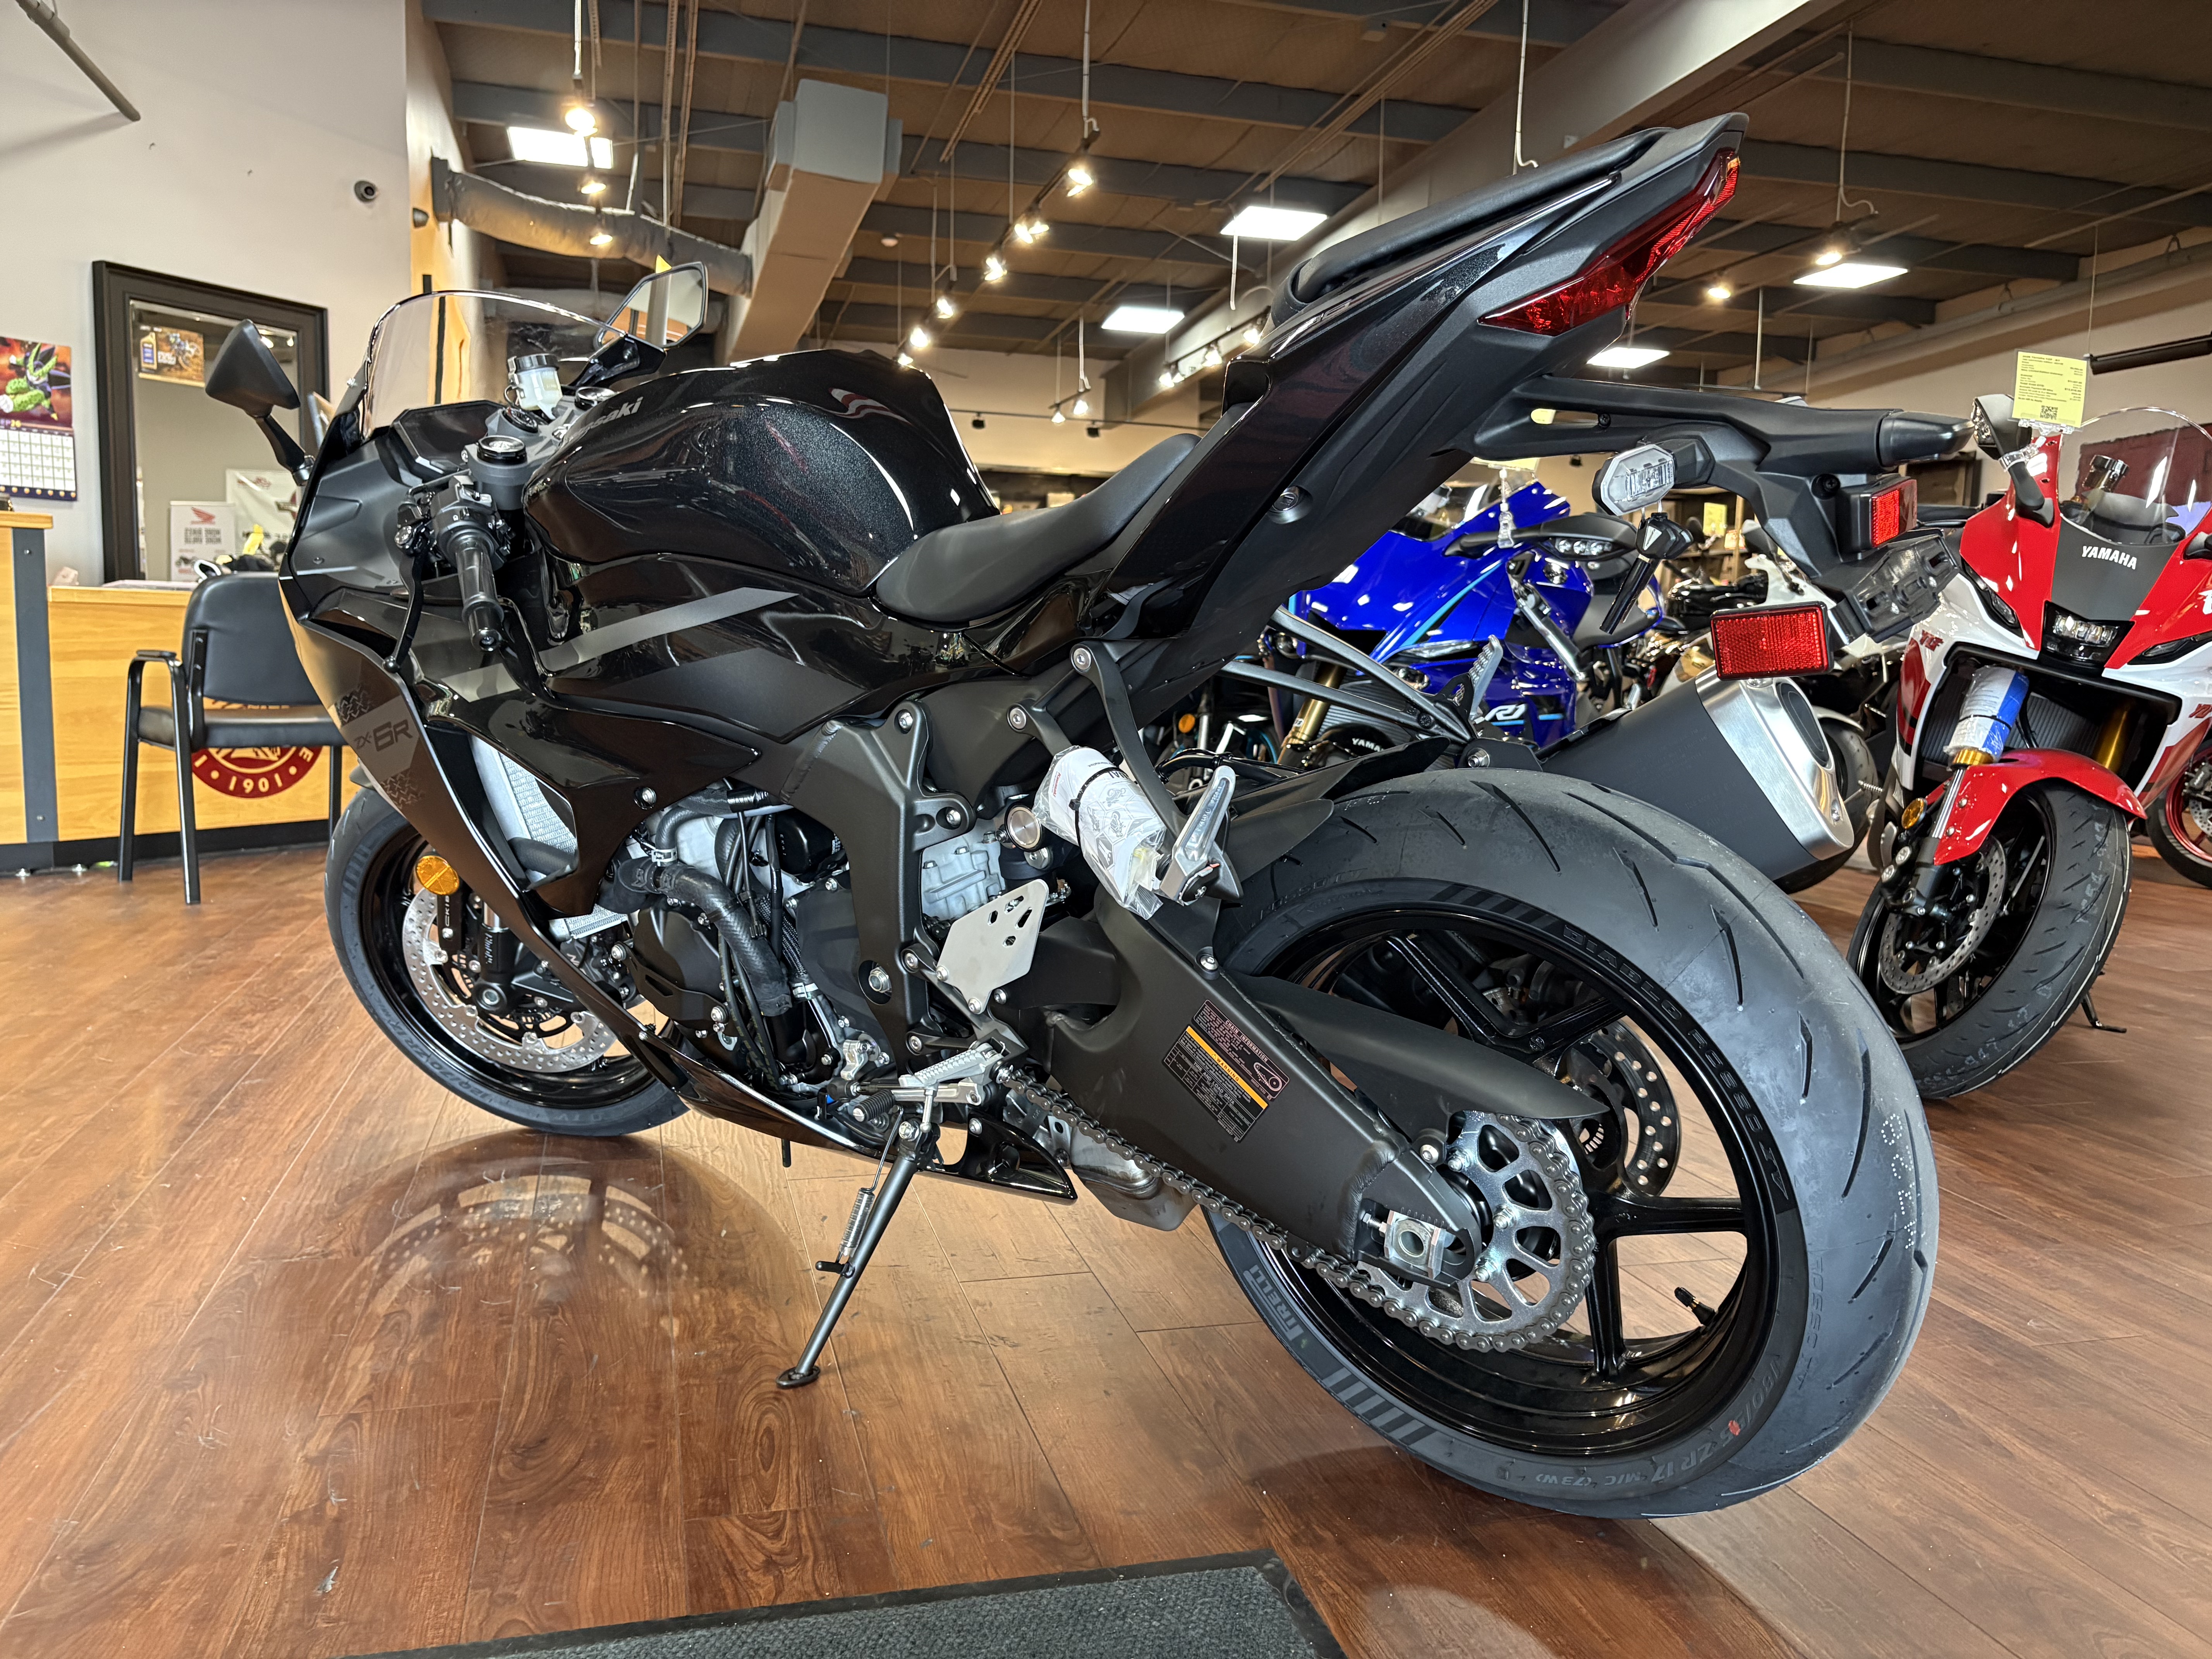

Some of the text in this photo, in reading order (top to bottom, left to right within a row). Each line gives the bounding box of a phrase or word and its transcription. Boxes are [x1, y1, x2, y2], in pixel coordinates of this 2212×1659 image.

[2082, 546, 2138, 569] YAMAHA
[354, 719, 413, 751] ZX-6R
[229, 773, 282, 793] 1901
[1224, 1020, 1268, 1062] CHAIN INFORMATION
[1563, 924, 1683, 1020] DIABLO
[1687, 1028, 1765, 1132] ROSSO
[1193, 1061, 1235, 1105] TIRE AND LOAD DATA
[1216, 1058, 1240, 1081] WARNING
[1243, 1264, 1304, 1341] PIRELLI
[1680, 1444, 1714, 1471] ZR
[1605, 1472, 1642, 1486] M/C
[1650, 1464, 1674, 1482] 17
